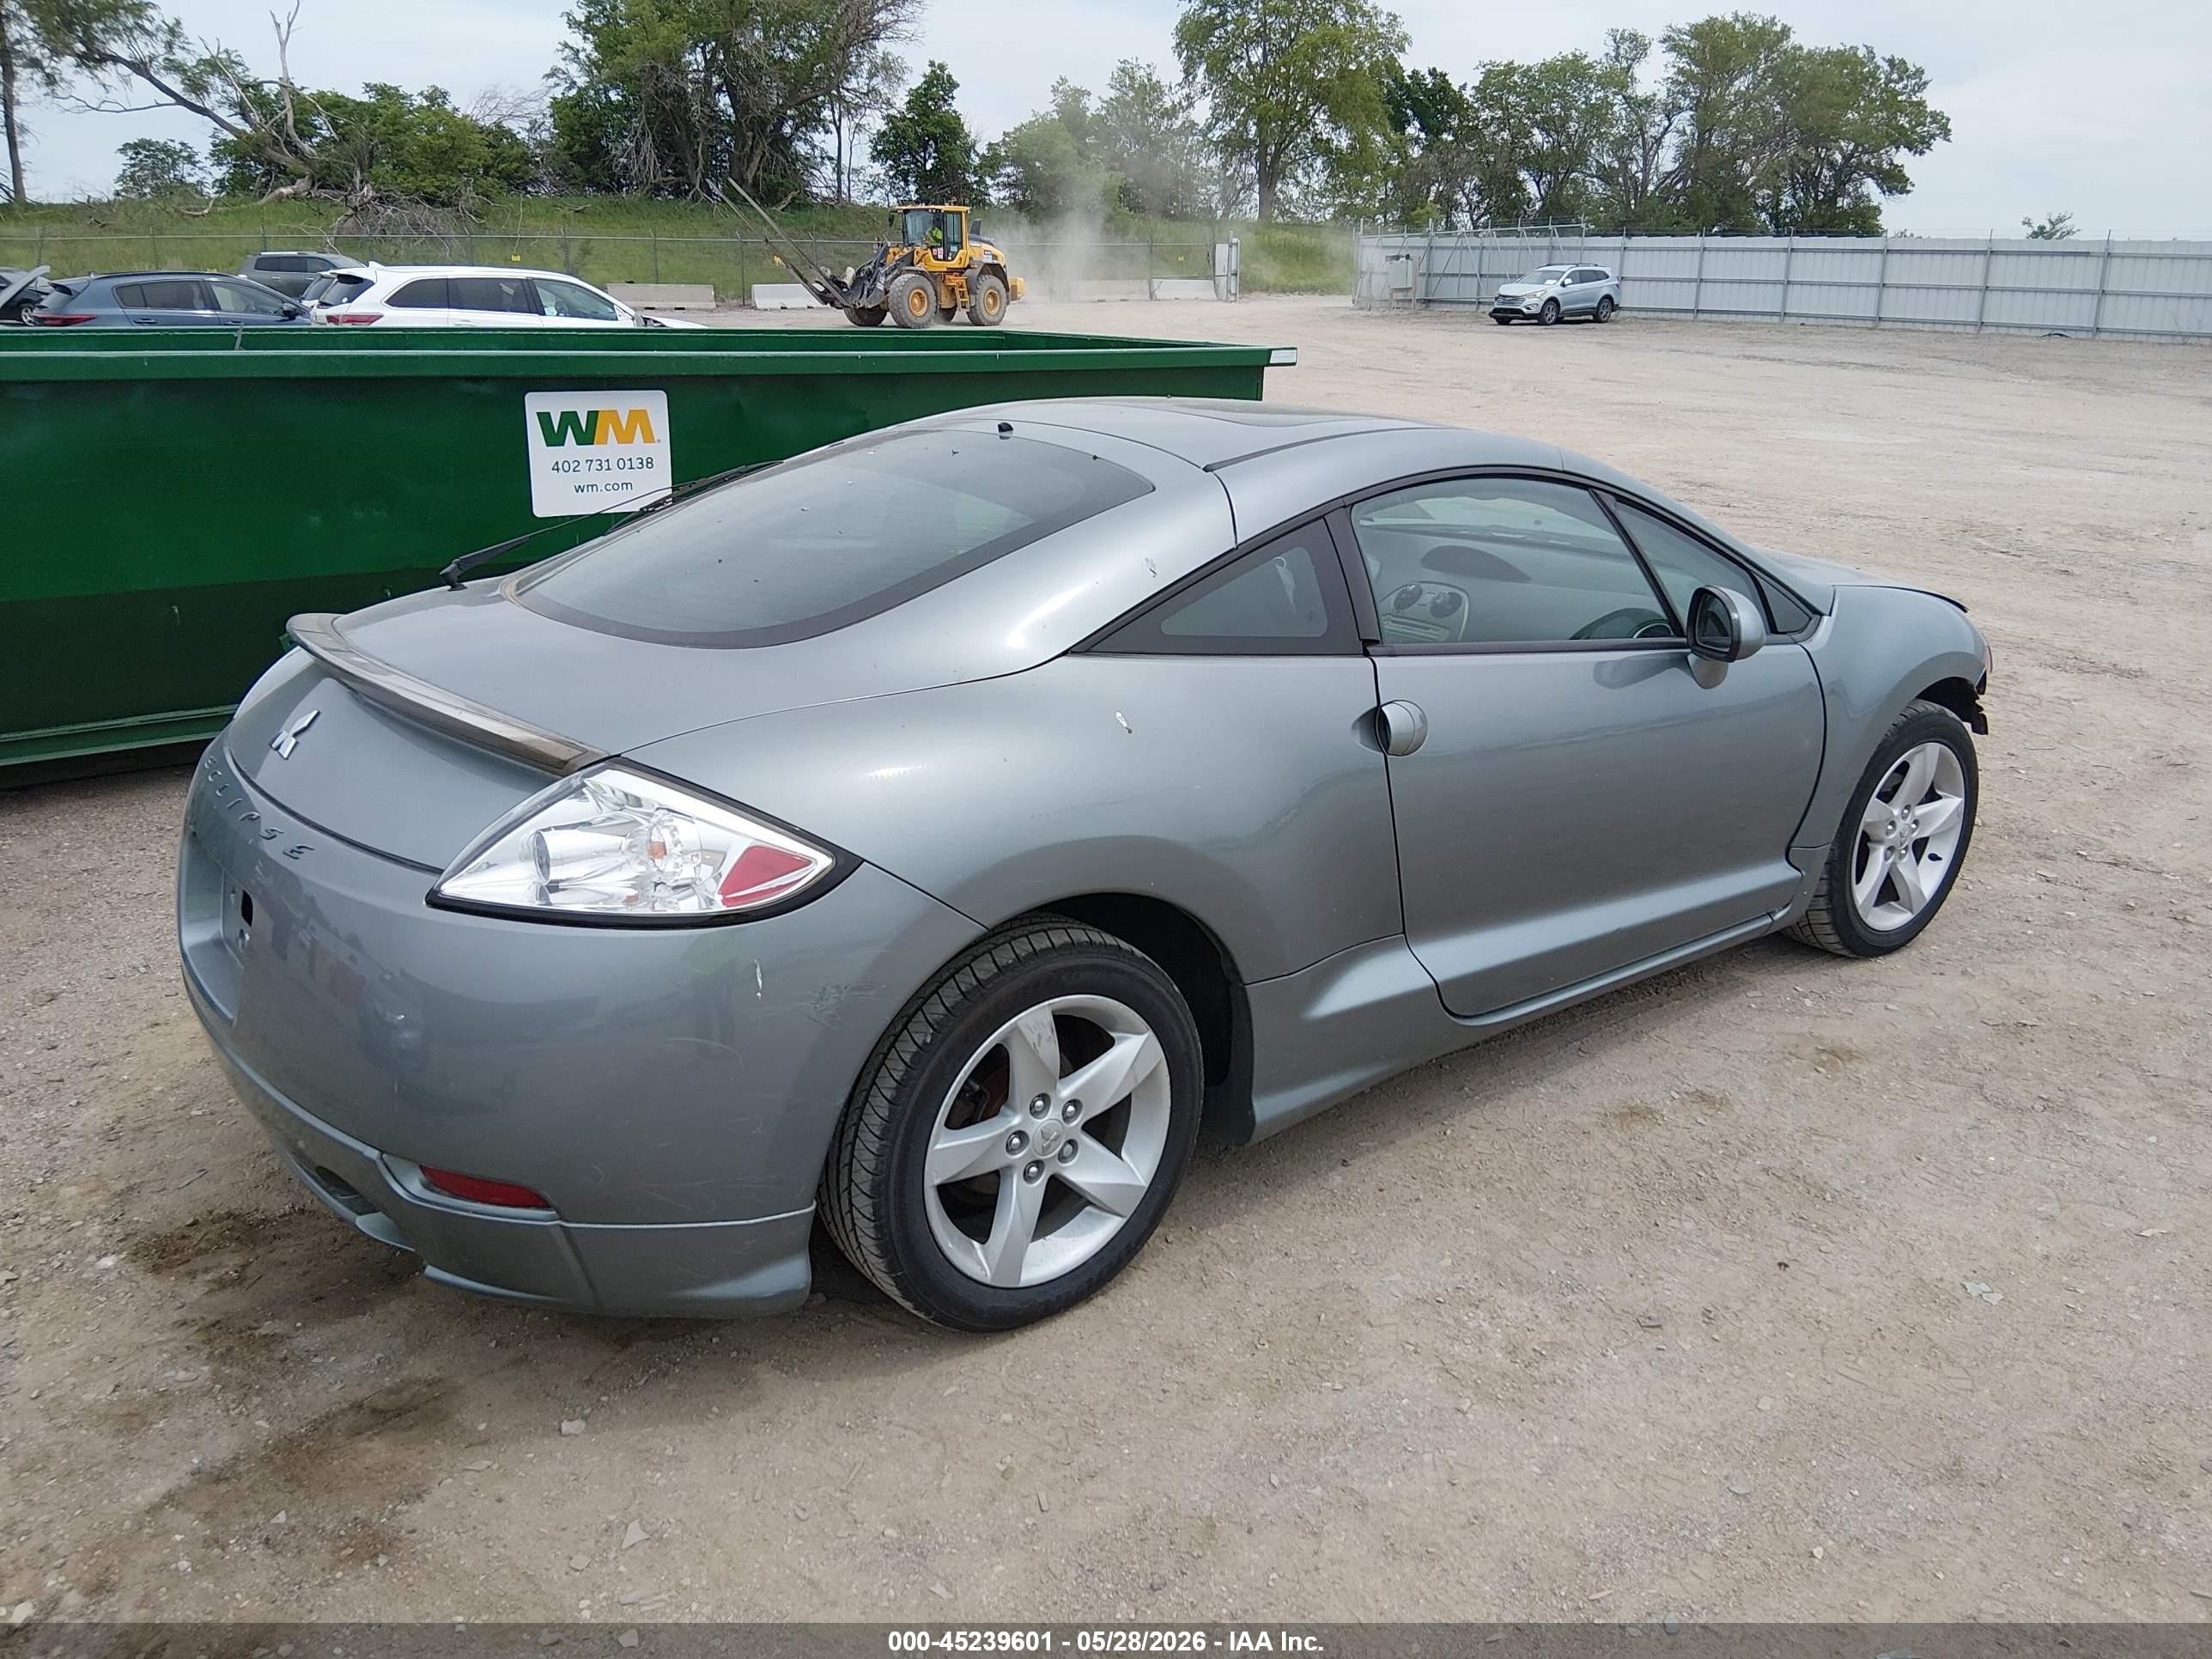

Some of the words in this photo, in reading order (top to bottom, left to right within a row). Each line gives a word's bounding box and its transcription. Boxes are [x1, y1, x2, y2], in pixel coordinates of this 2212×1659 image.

[536, 409, 656, 447] WM
[551, 459, 581, 473] 402
[586, 458, 612, 471] 731
[617, 456, 654, 470] 0138
[574, 481, 633, 493] wm.com
